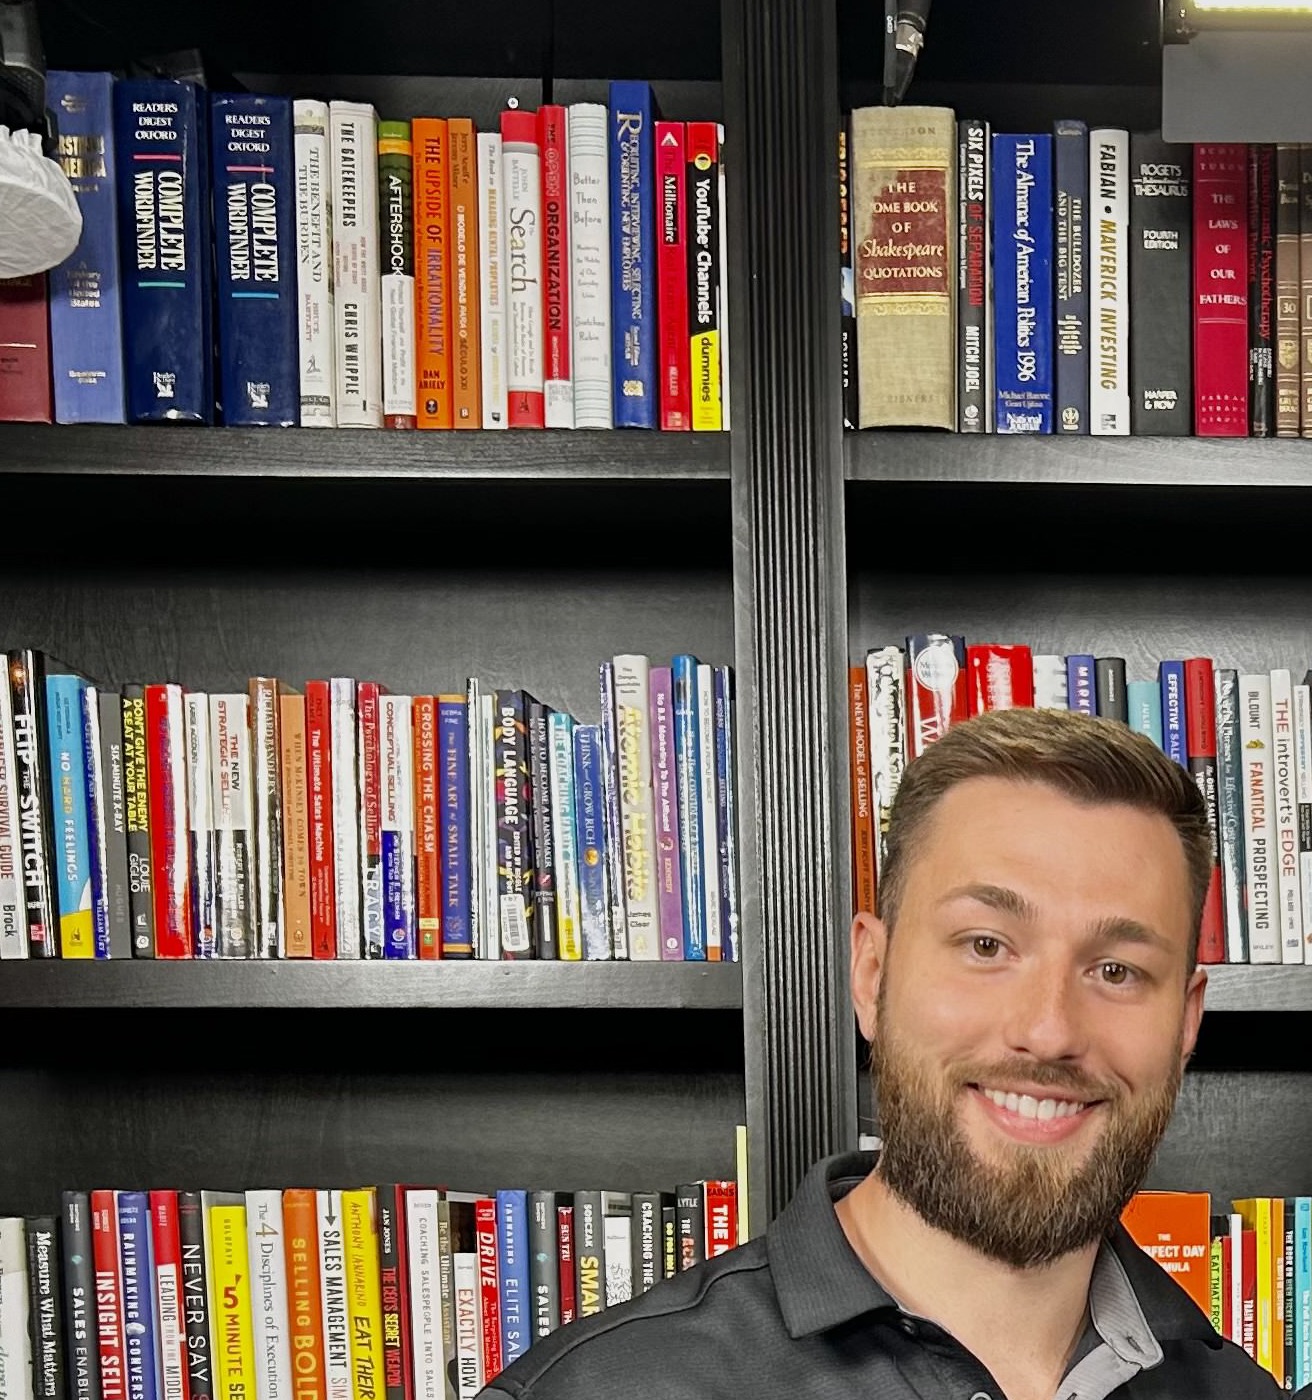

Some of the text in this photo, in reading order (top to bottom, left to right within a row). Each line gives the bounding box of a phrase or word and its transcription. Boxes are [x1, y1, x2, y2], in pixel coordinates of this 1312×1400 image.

[425, 137, 441, 164] THE
[968, 127, 983, 153] SIX
[1016, 140, 1034, 169] The
[426, 169, 441, 220] UPSIDE
[888, 182, 916, 193] THE
[903, 201, 938, 214] BOOK
[158, 171, 185, 270] COMPLETE
[250, 183, 279, 281] COMPLETE
[430, 224, 441, 243] OF
[891, 222, 911, 234] OF
[509, 208, 537, 293] Search
[863, 239, 944, 261] Shakespeare
[863, 267, 942, 279] QUOTATIONS
[1101, 144, 1117, 389] FABIAN MAVERICK INVESTING
[1210, 269, 1236, 279] OUR
[1215, 244, 1231, 254] OF
[696, 252, 712, 324] Channels
[1018, 351, 1036, 382] 1996
[422, 704, 435, 852] CROSSING THE CHASM
[501, 707, 519, 825] BODY LANGUAGE
[1281, 829, 1295, 877] EDGE
[1253, 838, 1269, 930] PROSPECTING
[123, 1233, 139, 1320] RAINMAKING
[323, 1230, 339, 1273] SALES
[183, 1243, 206, 1324] NEVER
[292, 1238, 310, 1331] SELLING
[72, 1288, 86, 1340] SALES
[96, 1272, 119, 1347] INSIGHT
[326, 1276, 347, 1369] MANAGEMENT
[355, 1315, 372, 1350] EAT
[188, 1335, 209, 1382] SAY
[225, 1313, 242, 1376] MINUTE
[458, 1289, 477, 1389] EXACTLY HOW
